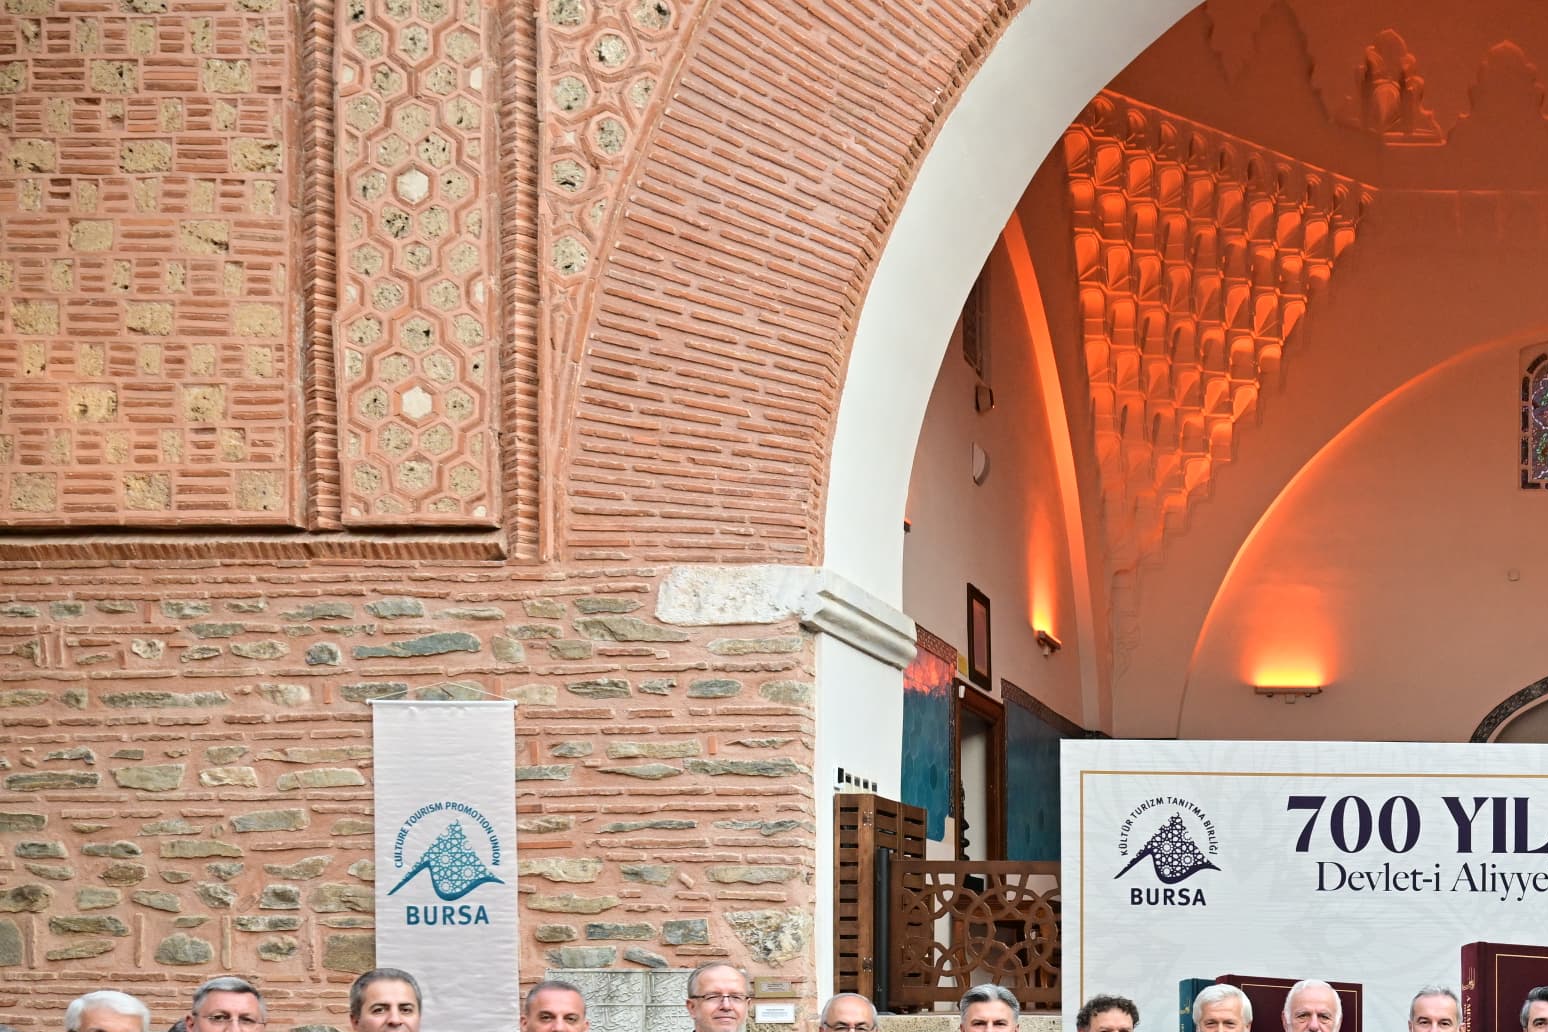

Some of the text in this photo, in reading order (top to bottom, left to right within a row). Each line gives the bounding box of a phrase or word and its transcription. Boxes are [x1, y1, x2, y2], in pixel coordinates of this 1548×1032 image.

[394, 801, 501, 868] CULTURE TOURISM PROMOTION UNION
[1118, 819, 1134, 856] KÜLTÜR
[1167, 796, 1206, 820] TANITMA
[1286, 795, 1421, 854] 700
[1130, 887, 1207, 906] BURSA
[1316, 861, 1441, 892] Devlet-i
[406, 905, 490, 926] BURSA
